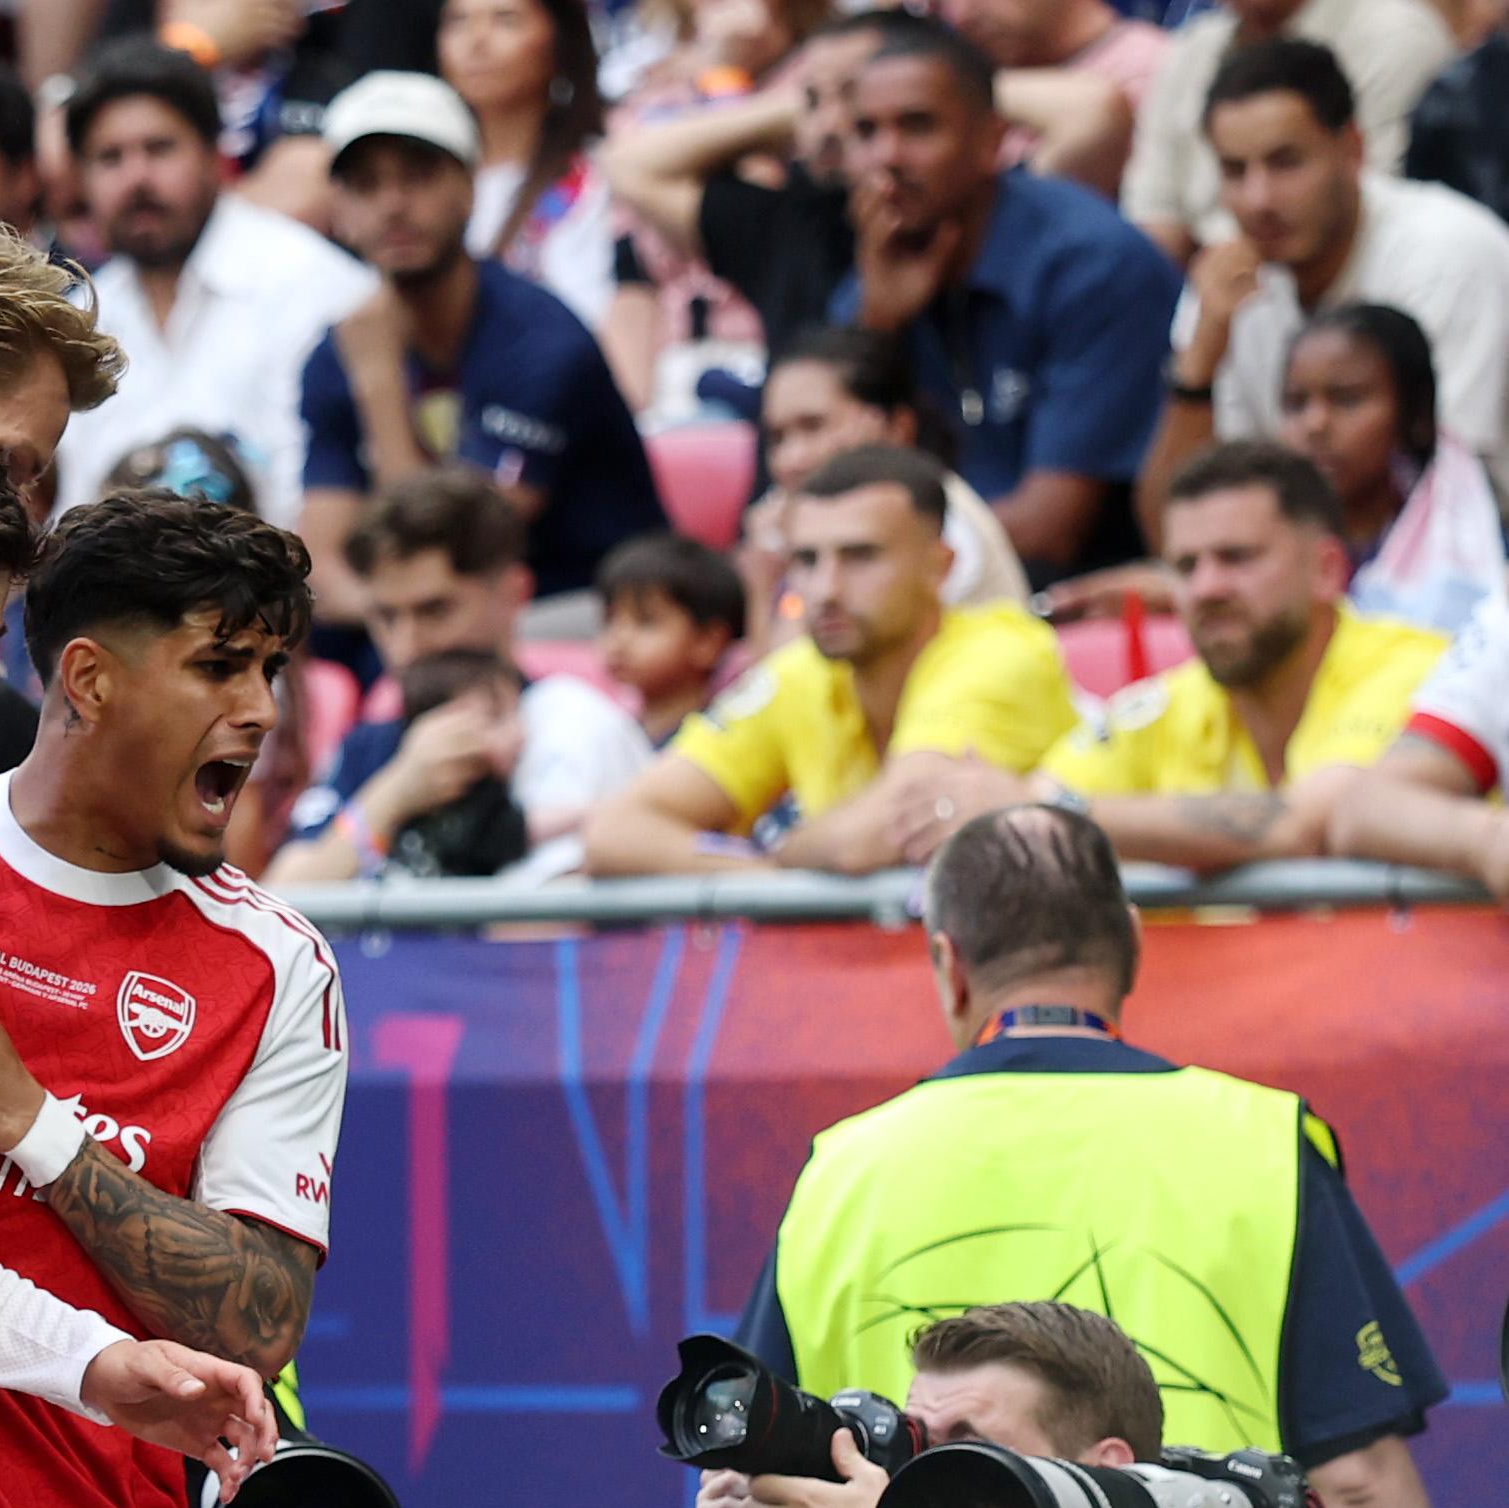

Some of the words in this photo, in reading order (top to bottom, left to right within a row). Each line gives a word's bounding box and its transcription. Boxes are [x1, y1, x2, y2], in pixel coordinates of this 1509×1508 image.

[9, 956, 71, 988] BUDAPEST
[69, 979, 97, 996] 2026
[132, 983, 185, 1017] Arsenal
